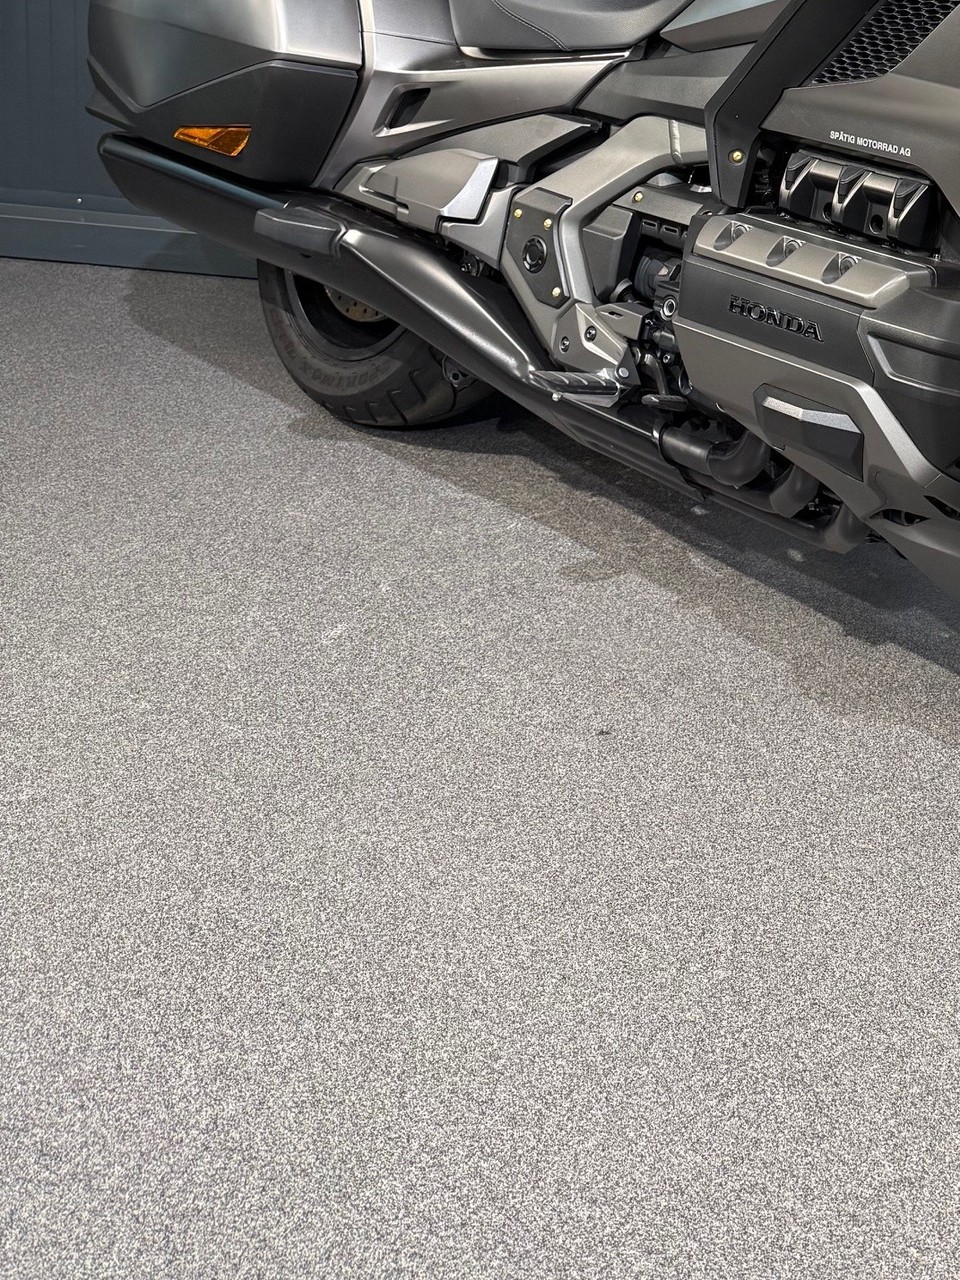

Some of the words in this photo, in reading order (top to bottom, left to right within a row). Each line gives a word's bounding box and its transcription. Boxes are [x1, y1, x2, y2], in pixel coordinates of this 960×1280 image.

[856, 137, 899, 154] MOTORRAD
[899, 147, 911, 157] AG
[728, 294, 825, 343] HONDA
